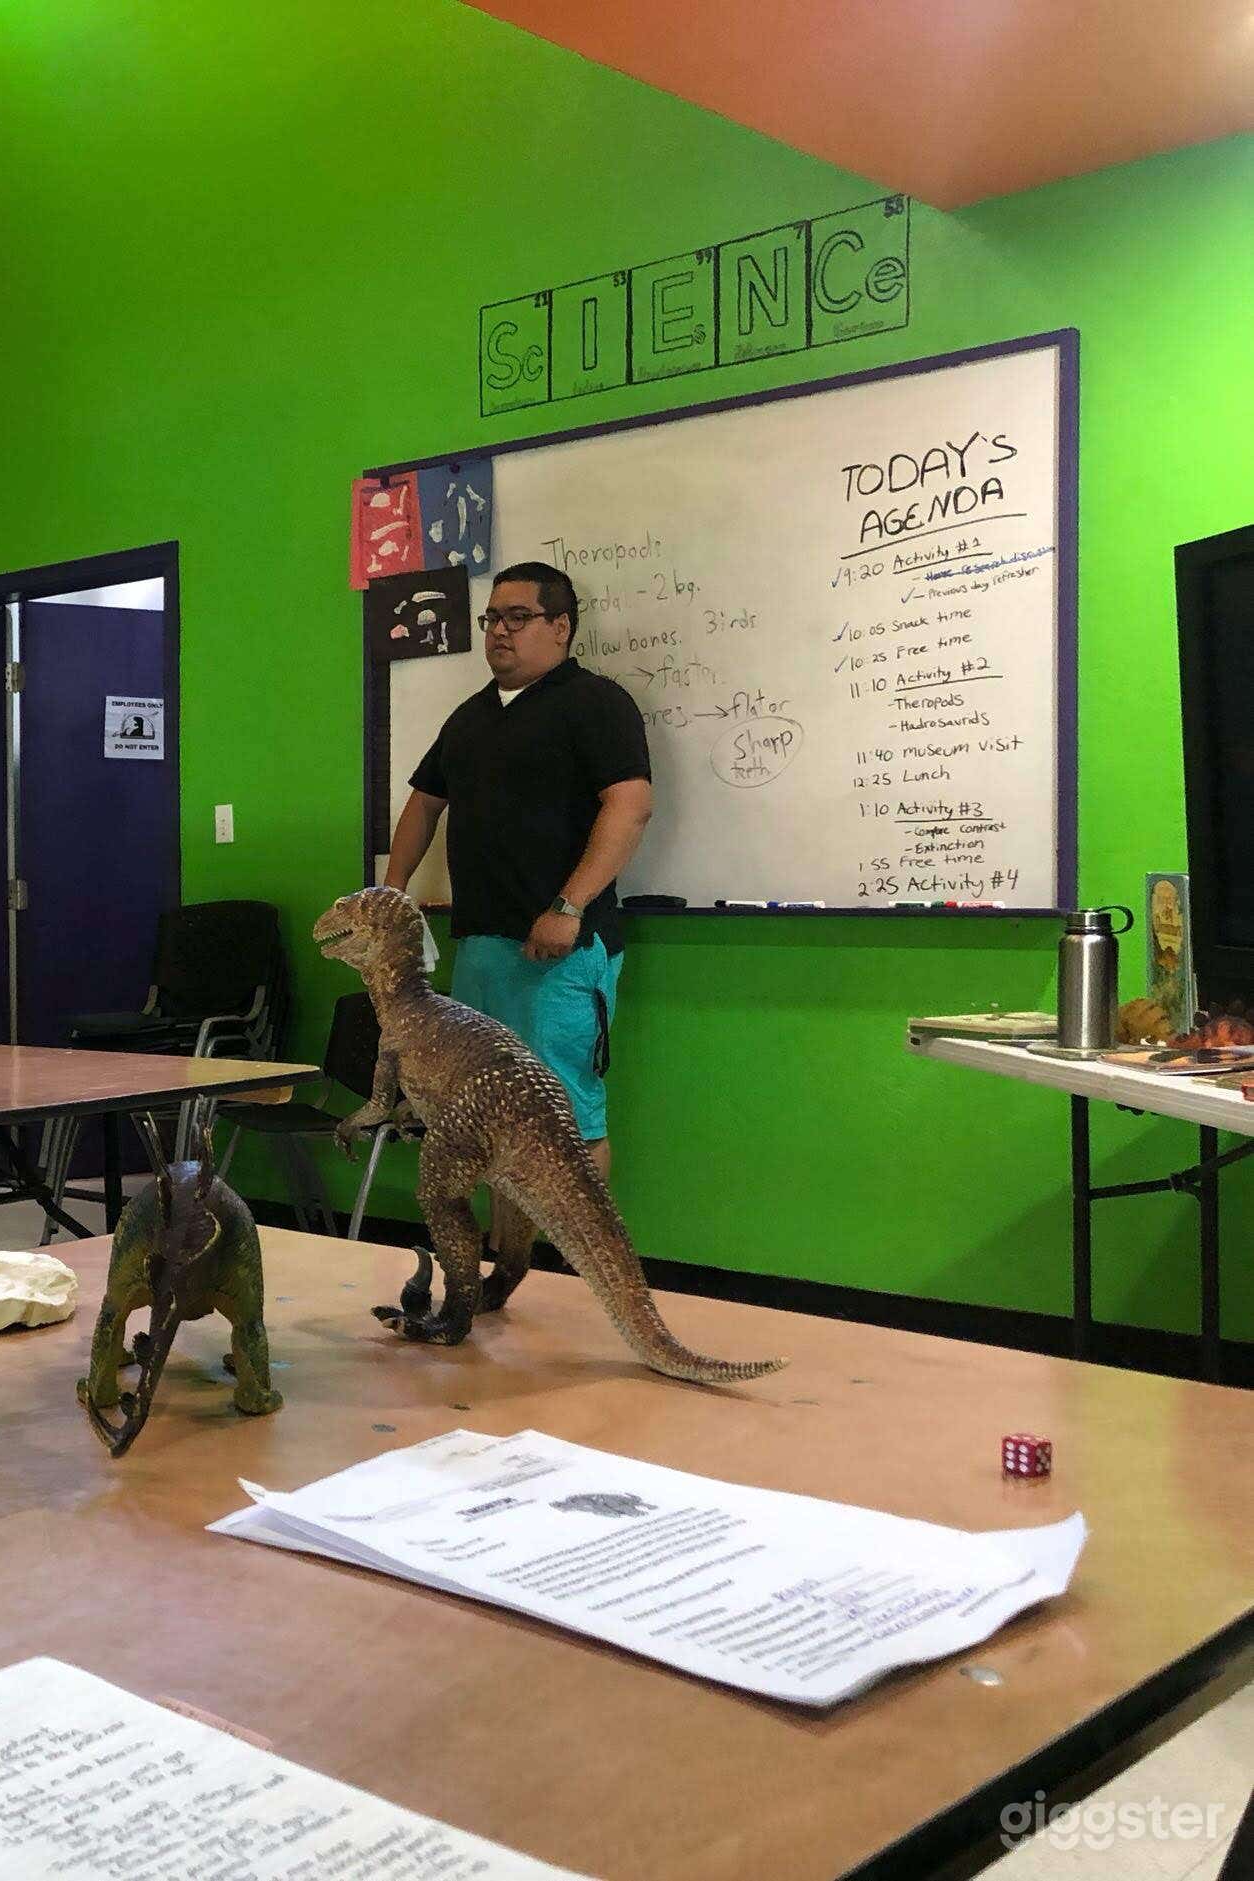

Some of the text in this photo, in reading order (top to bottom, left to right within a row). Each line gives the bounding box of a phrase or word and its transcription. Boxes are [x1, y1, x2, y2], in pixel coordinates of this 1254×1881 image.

[737, 246, 789, 336] N
[841, 431, 1018, 502] TODAY'S
[859, 477, 1004, 544] AGENDA
[893, 545, 949, 571] Activity
[654, 572, 668, 600] 2
[970, 577, 990, 592] day
[891, 616, 929, 632] Snack
[937, 608, 972, 622] time
[575, 629, 622, 657] ollow
[896, 644, 928, 659] Free
[938, 633, 973, 648] time
[896, 666, 951, 685] Activity
[902, 765, 951, 783] Lunch
[896, 801, 953, 818] Activity
[944, 853, 985, 865] time
[907, 873, 985, 898] Activity
